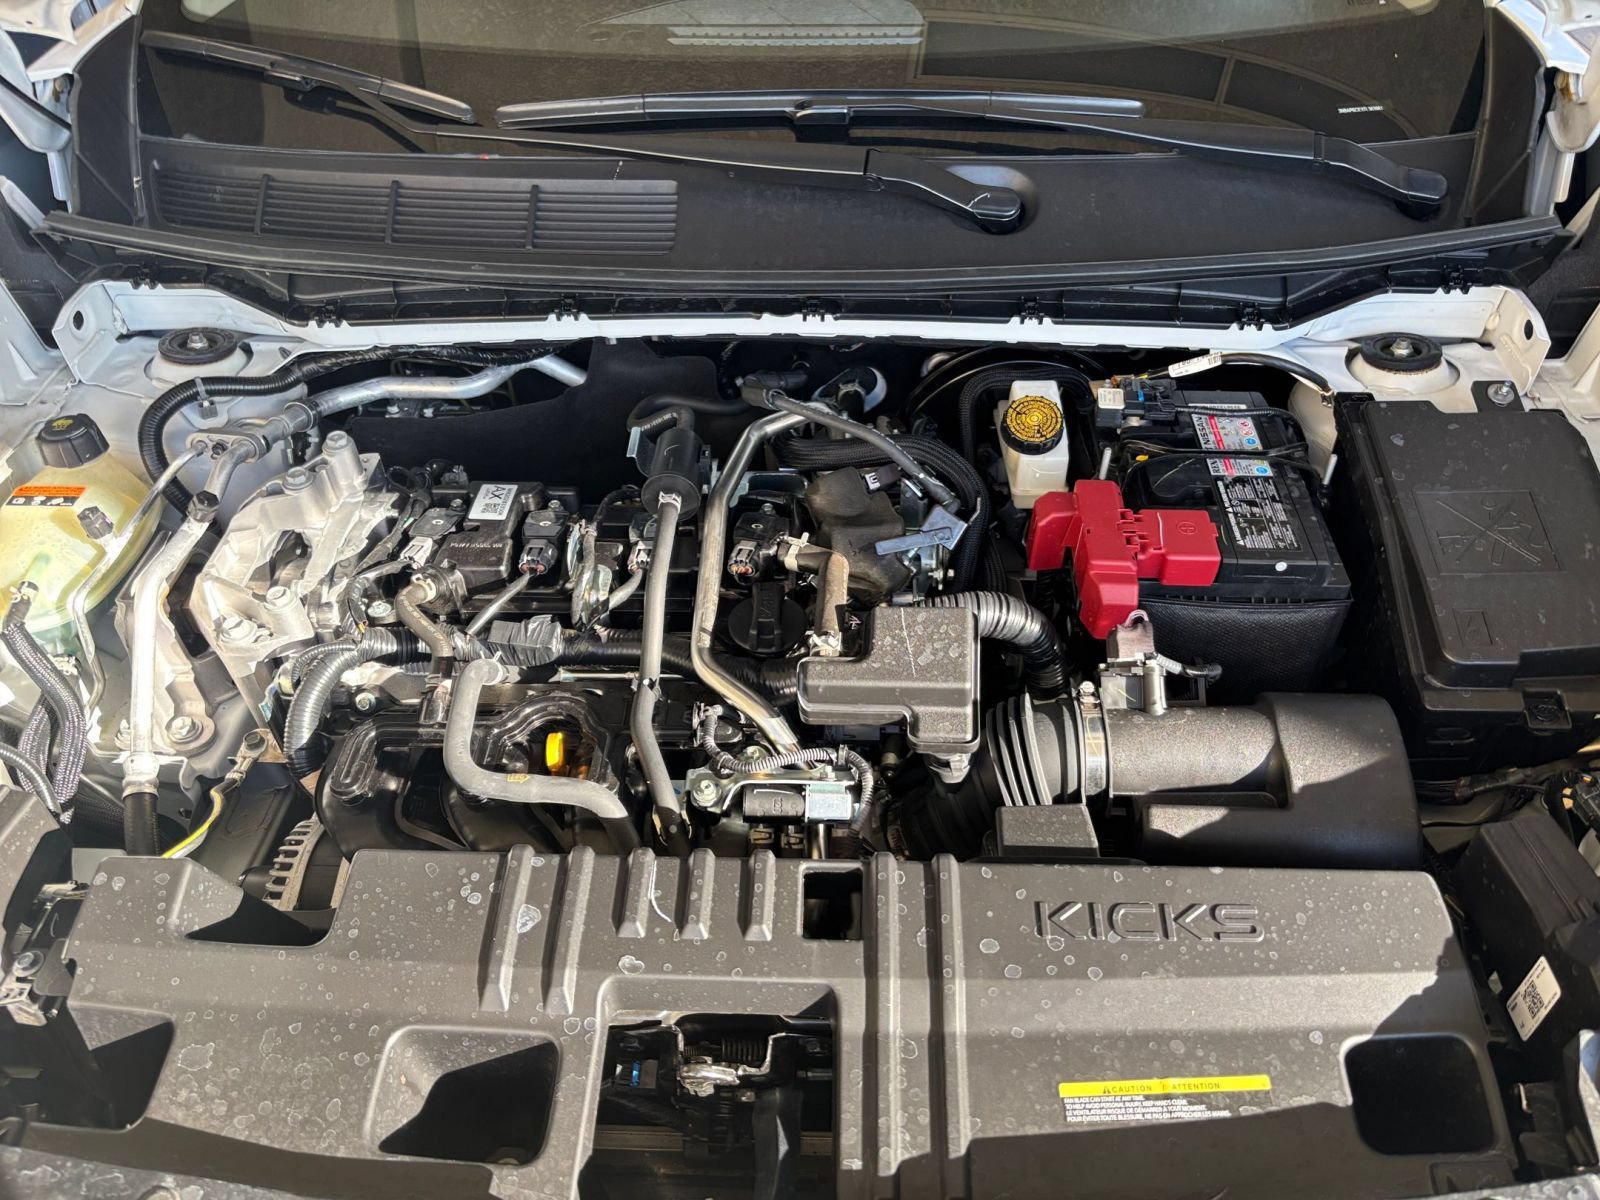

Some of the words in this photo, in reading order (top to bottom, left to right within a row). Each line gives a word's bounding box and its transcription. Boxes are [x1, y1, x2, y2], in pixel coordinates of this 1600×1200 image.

[1195, 416, 1212, 444] NISSAN
[488, 486, 506, 500] AX
[1034, 901, 1264, 942] KICKS
[1112, 1086, 1152, 1094] CAUTION
[1172, 1082, 1220, 1090] ATTENTION
